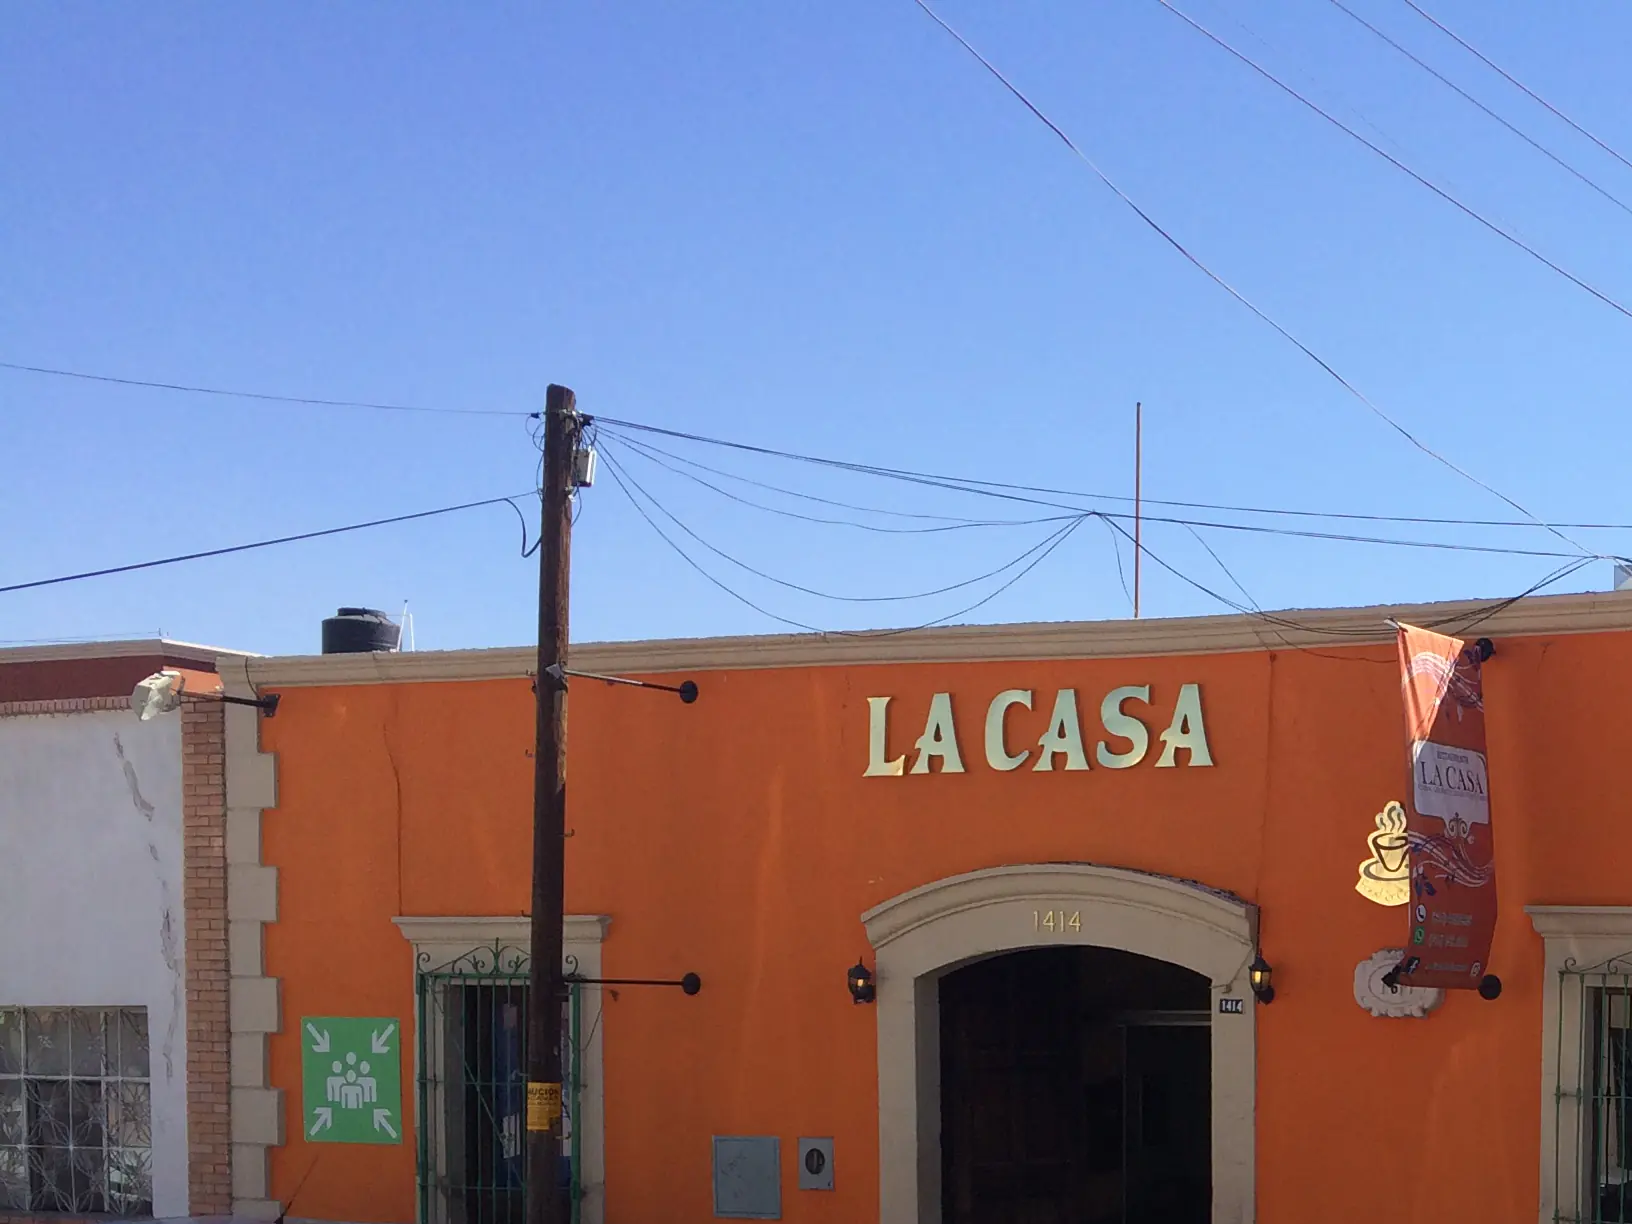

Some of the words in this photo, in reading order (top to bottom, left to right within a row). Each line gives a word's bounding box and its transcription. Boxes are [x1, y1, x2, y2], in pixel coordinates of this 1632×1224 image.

[863, 692, 966, 778] LA
[984, 683, 1214, 772] CASA
[1420, 761, 1443, 787] LA
[1446, 765, 1484, 795] CASA
[1033, 910, 1082, 932] 1414
[1221, 1000, 1243, 1012] 1414
